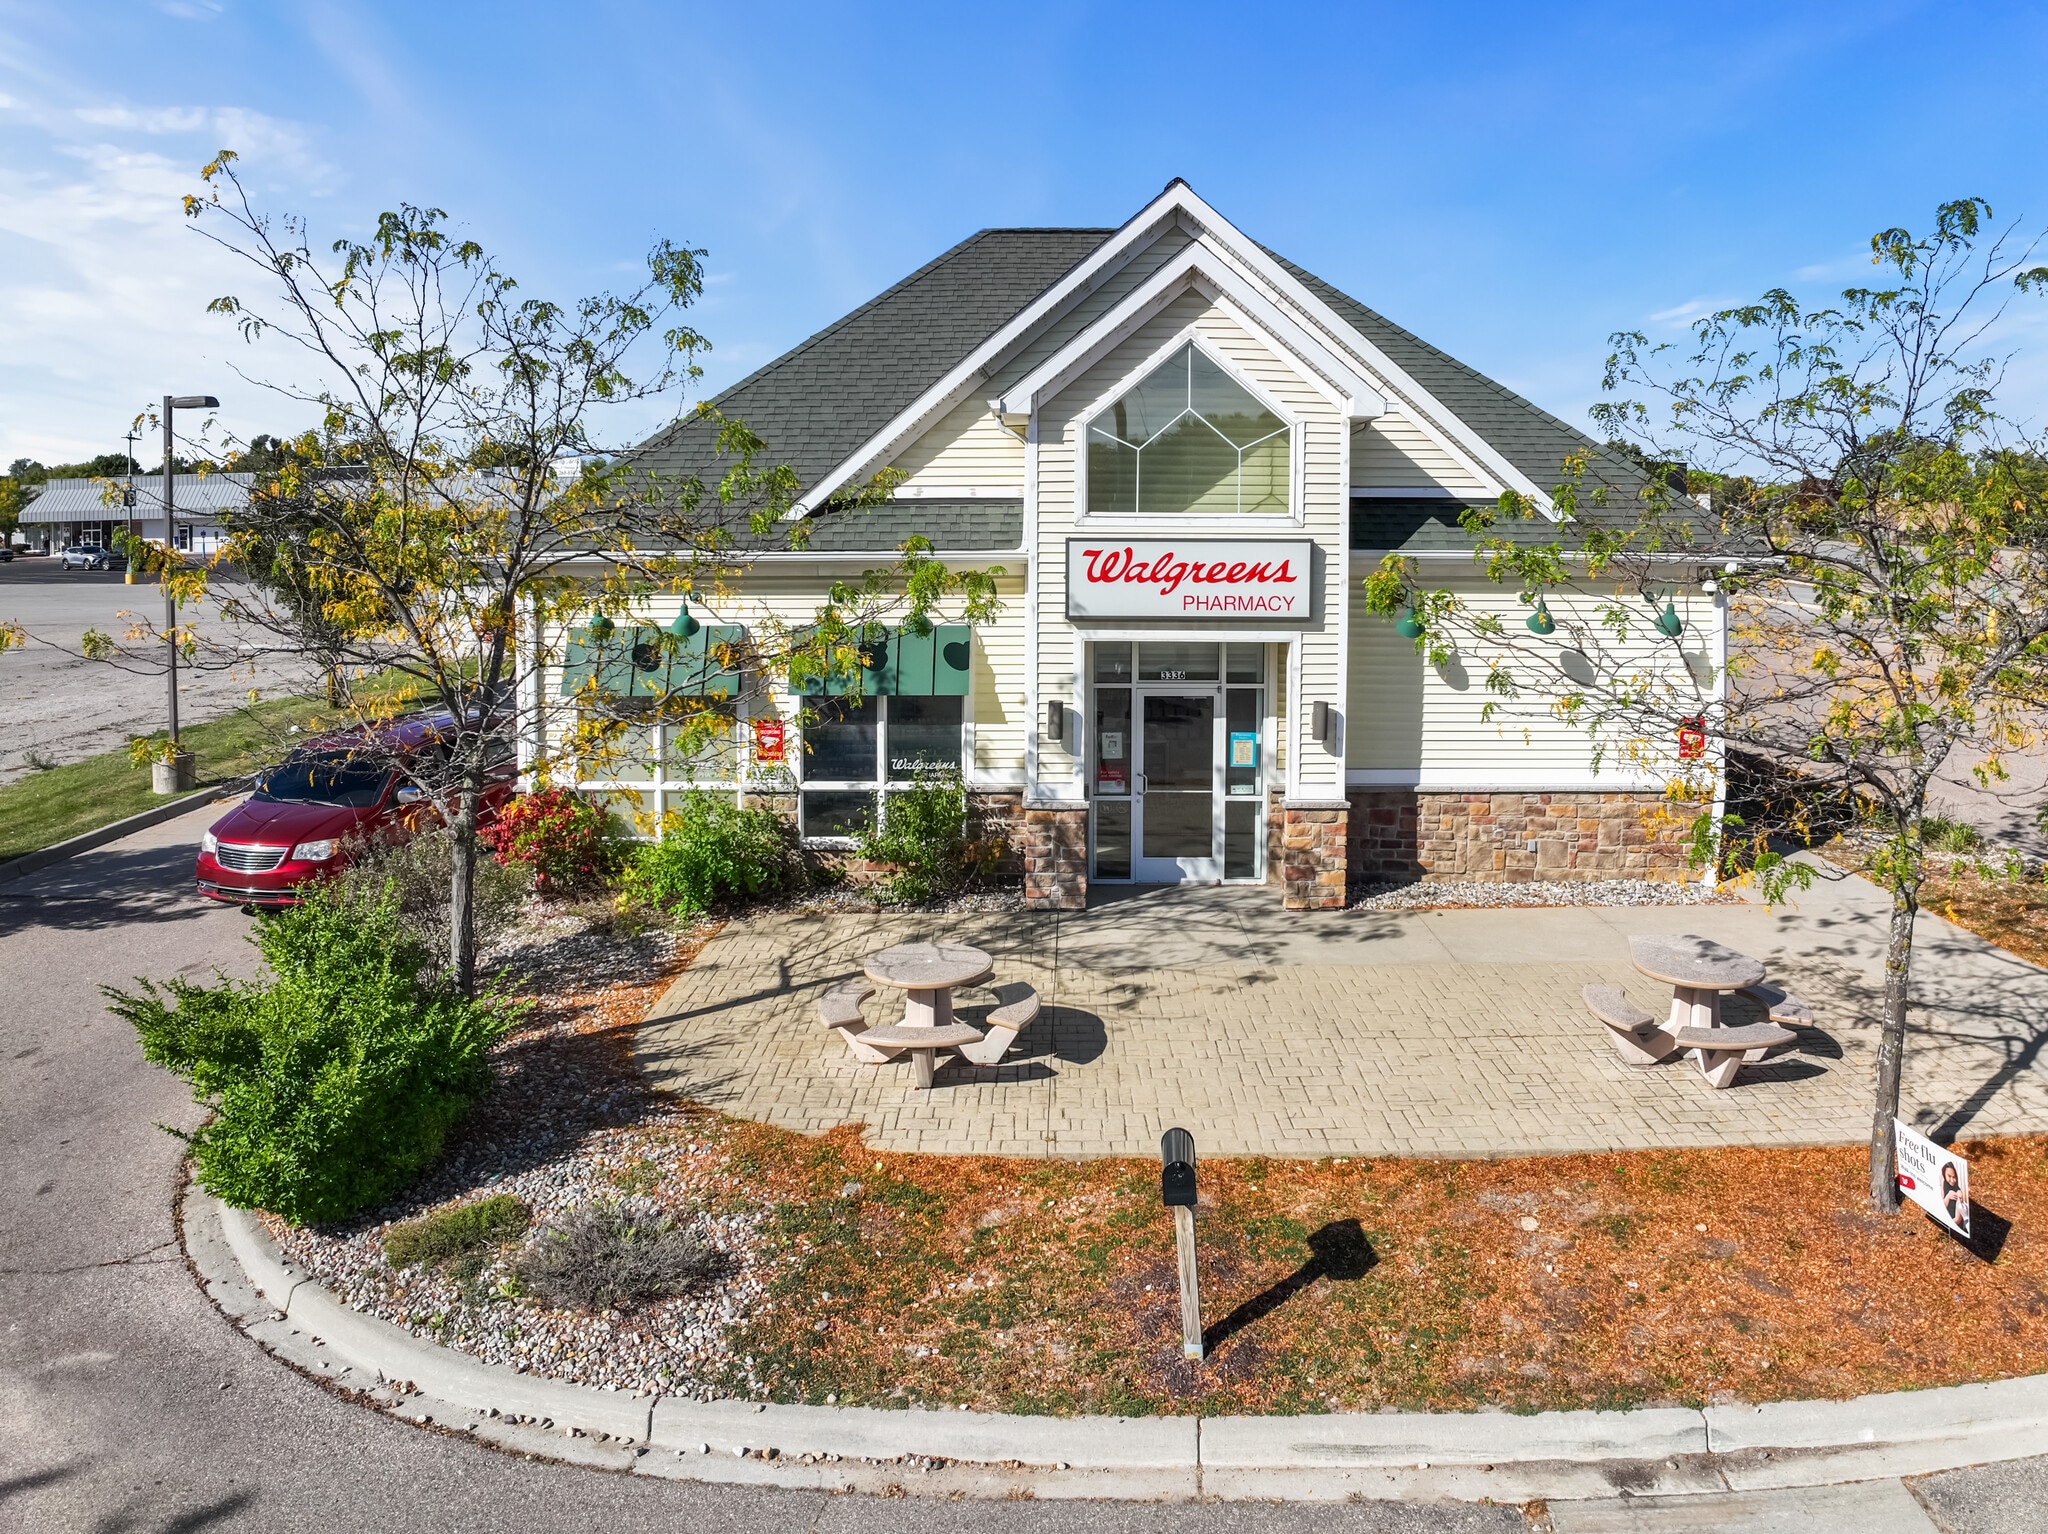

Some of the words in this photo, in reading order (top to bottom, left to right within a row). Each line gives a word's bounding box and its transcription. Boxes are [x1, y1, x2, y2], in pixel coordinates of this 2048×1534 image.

[1082, 547, 1297, 595] Walgreens
[1183, 595, 1295, 611] PHARMACY
[1161, 671, 1185, 680] 3336
[891, 758, 956, 773] Walgreens
[1899, 1130, 1919, 1154] Free
[1921, 1144, 1936, 1165] flu
[1899, 1147, 1926, 1174] shots
